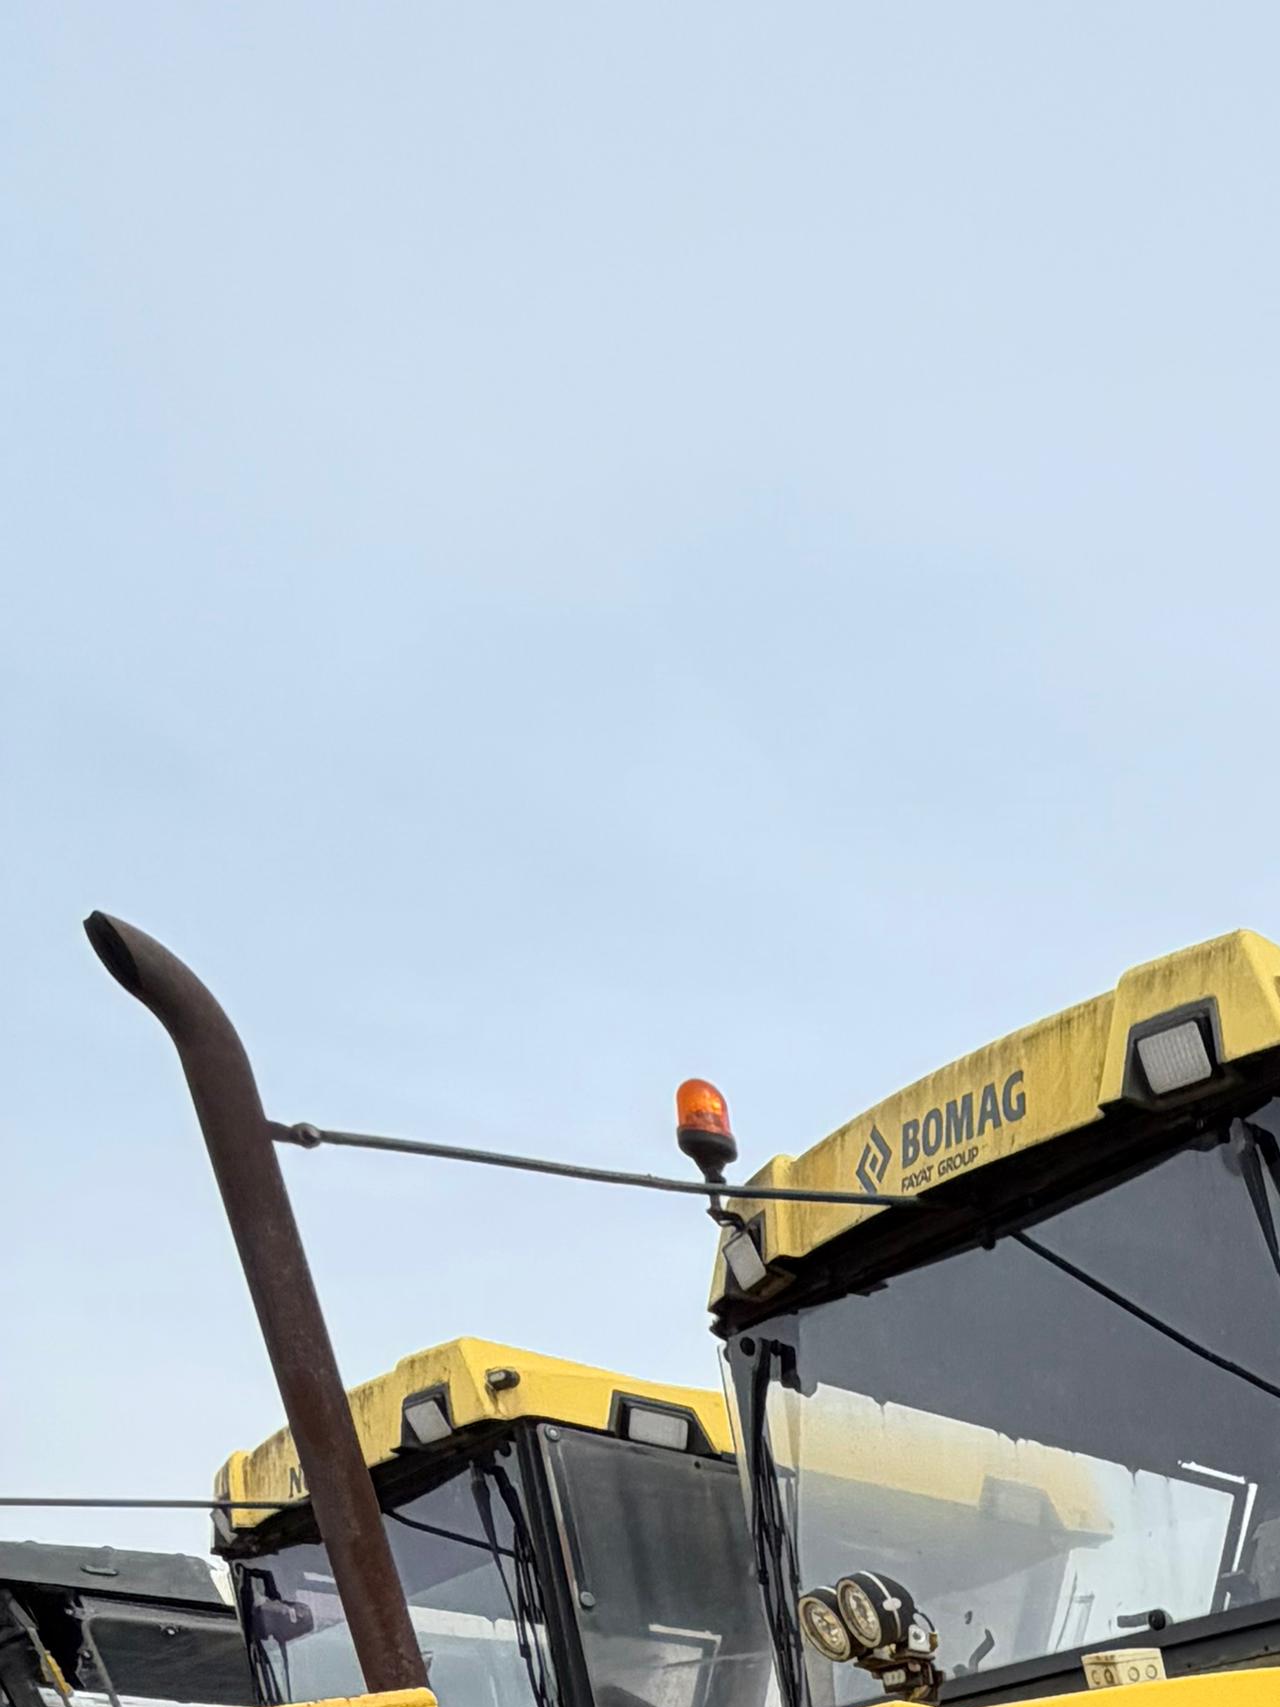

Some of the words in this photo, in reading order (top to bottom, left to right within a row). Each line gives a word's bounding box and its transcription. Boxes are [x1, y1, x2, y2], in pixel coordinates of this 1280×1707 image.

[902, 1070, 1027, 1169] BOMAG
[901, 1165, 935, 1193] FAYAT
[938, 1146, 979, 1177] GROUP
